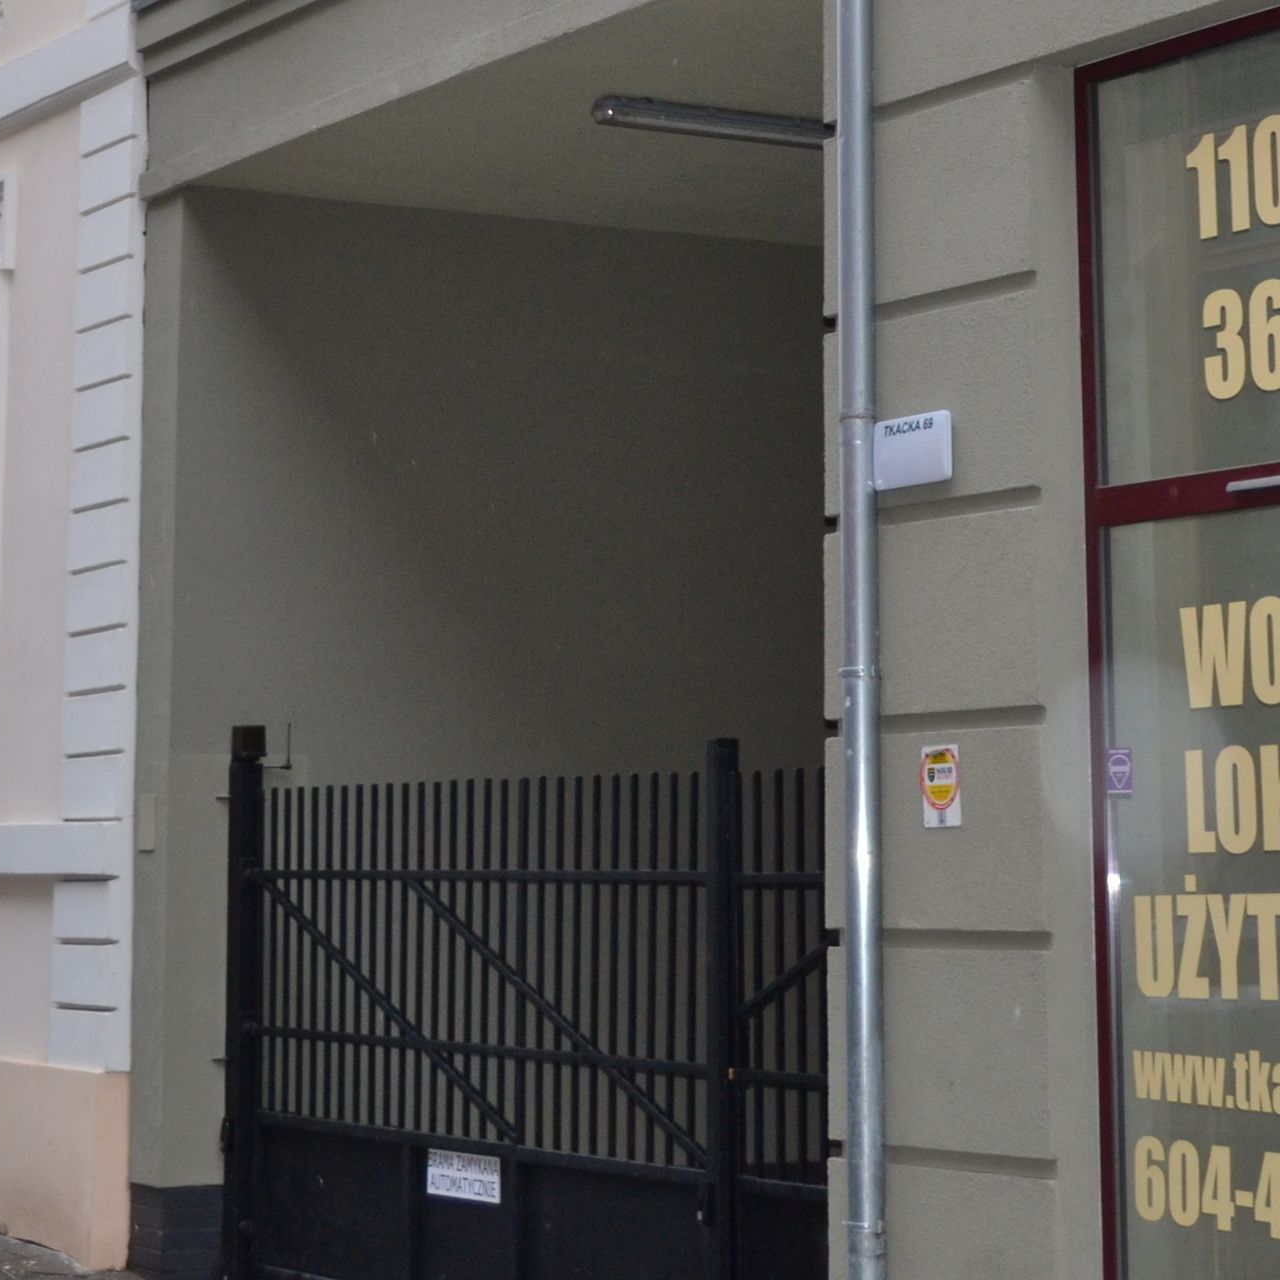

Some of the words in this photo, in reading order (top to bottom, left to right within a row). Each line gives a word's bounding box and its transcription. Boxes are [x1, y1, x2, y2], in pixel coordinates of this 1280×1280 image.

[884, 420, 921, 437] TKACKA
[456, 1154, 499, 1176] ZAMYKANA
[430, 1173, 496, 1198] AUTOMATYCZNIE
